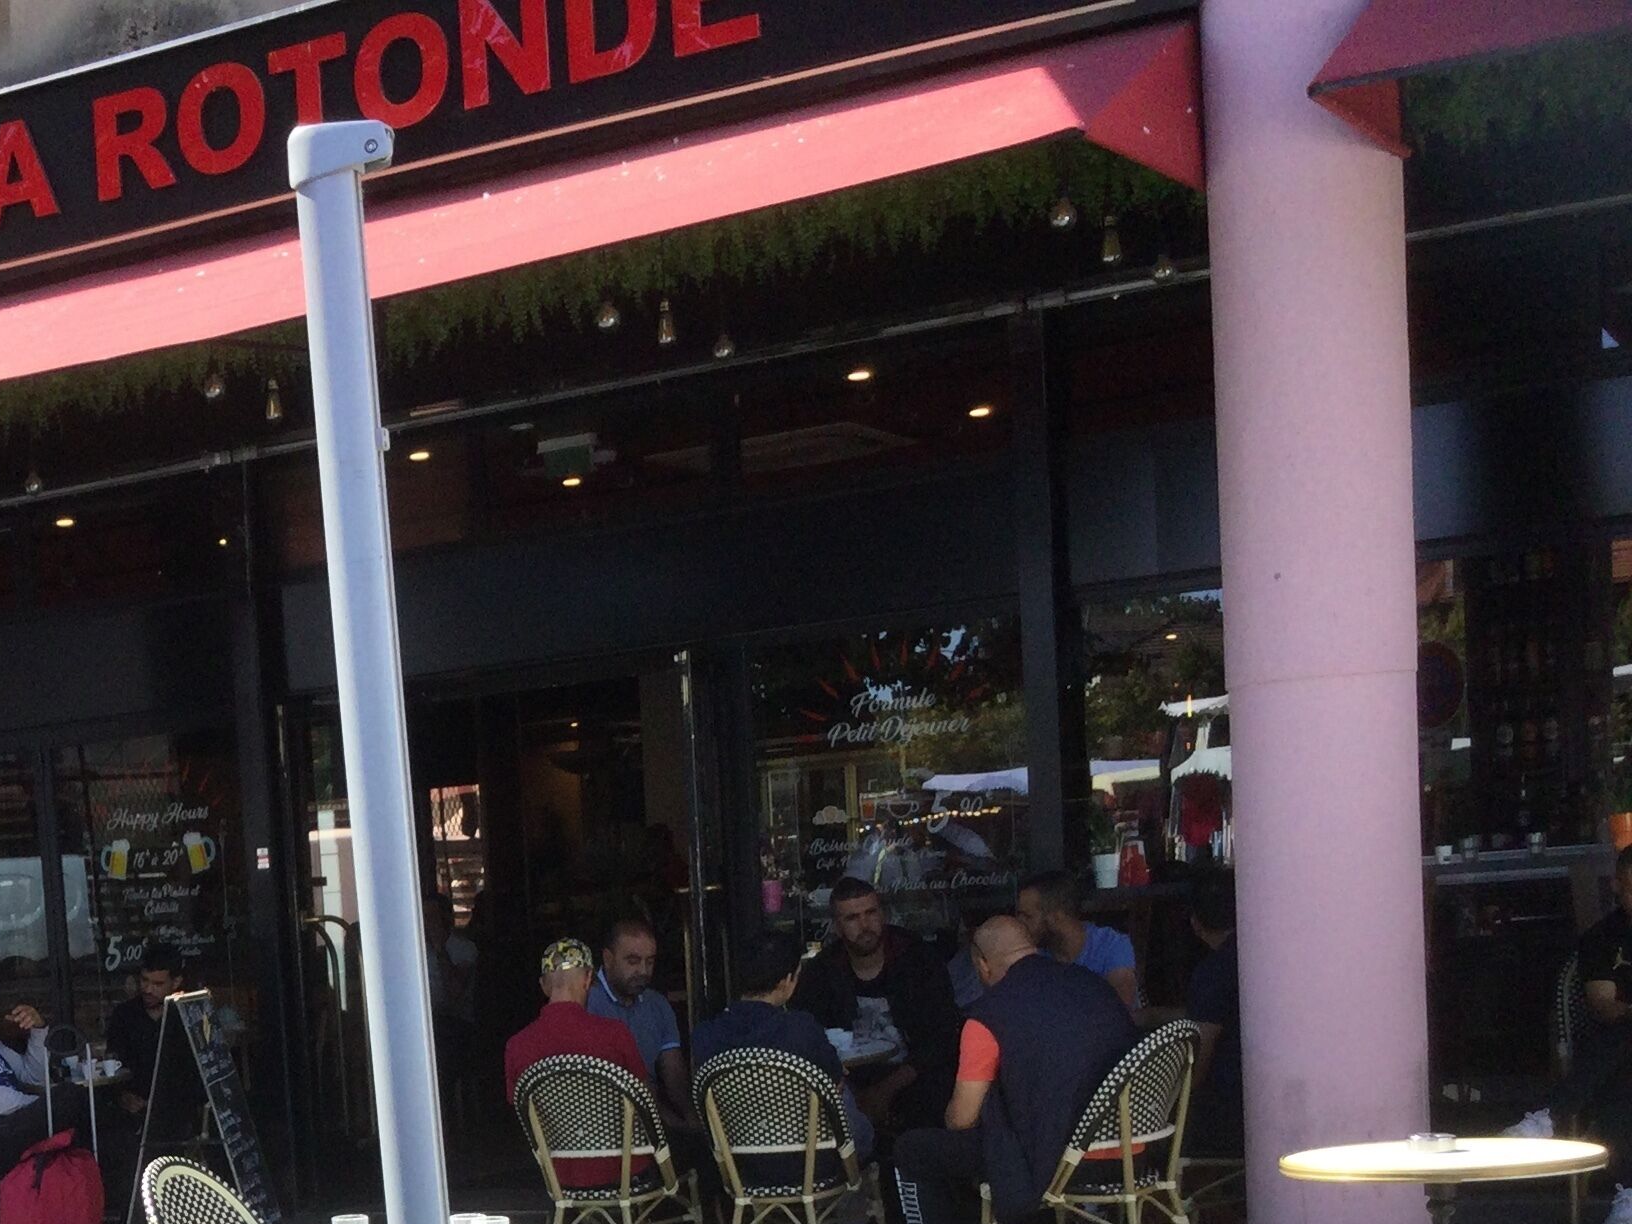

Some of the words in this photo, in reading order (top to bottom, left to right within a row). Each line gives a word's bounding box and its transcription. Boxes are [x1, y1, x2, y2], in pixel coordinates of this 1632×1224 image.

[849, 687, 937, 718] Formule
[827, 721, 880, 748] Petit
[107, 807, 159, 832] Happy
[161, 802, 209, 824] Hours
[950, 870, 1010, 889] Chocolat
